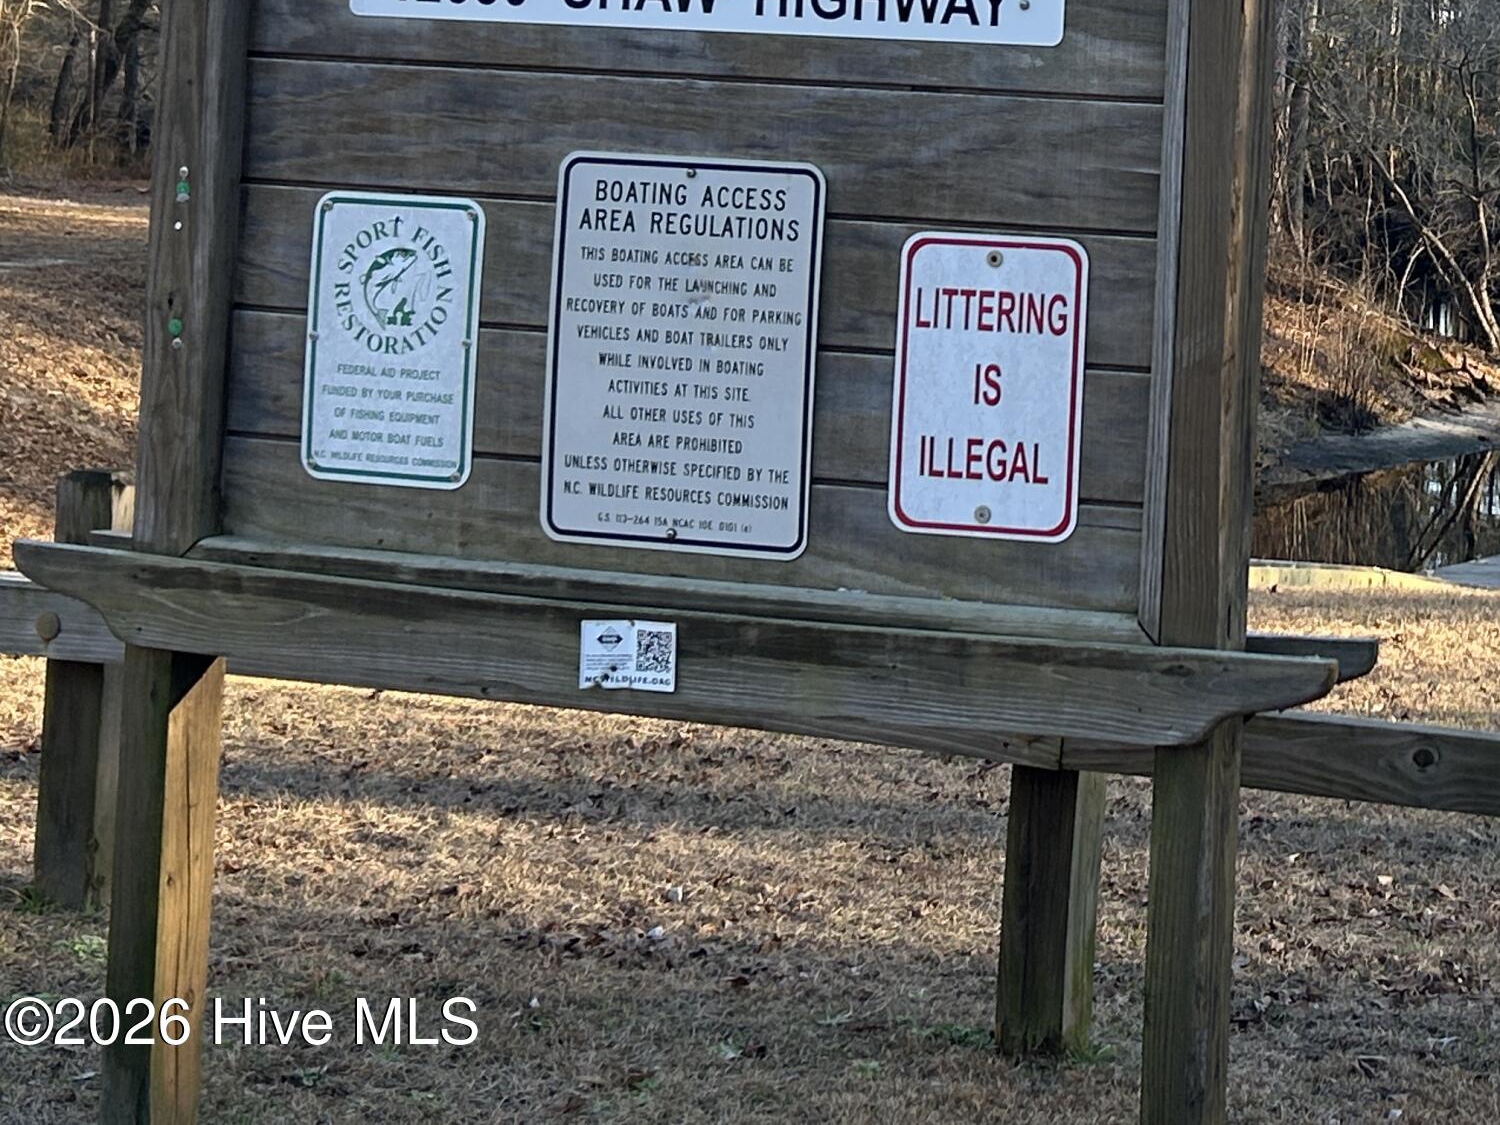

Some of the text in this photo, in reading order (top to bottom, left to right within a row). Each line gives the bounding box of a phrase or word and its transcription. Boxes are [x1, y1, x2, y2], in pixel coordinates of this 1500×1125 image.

[595, 179, 787, 211] BOATING ACCESS
[579, 208, 800, 241] AREA REGULATIONS
[337, 217, 453, 278] SPORT FISH
[581, 246, 794, 273] THIS BOATING ACCESS AREA CAN BE
[593, 273, 776, 297] USED FOR THE LAUNCHING AND
[334, 282, 454, 355] RESTORATION
[566, 297, 802, 326] RECOVERY OF BOATS AND FOR PARKING
[915, 287, 1068, 336] LITTERING
[577, 325, 789, 352] VEHICLES AND BOAT TRAILERS ONLY
[337, 363, 441, 380] FEDERAL AID PROJECT
[598, 352, 765, 376] WHILE INVOLVED IN BOATING
[322, 384, 455, 404] FUNDED BY YOUR PURCHASE
[608, 379, 668, 396] ACTIVITIES
[674, 383, 687, 397] AT
[694, 384, 719, 400] THIS
[974, 363, 1002, 406] IS
[334, 407, 440, 425] OF FISHING EQUIPMENT
[603, 405, 755, 429] ALL OTHER USES OF THIS
[329, 429, 444, 448] AND MOTOR BOAT FUELS
[613, 432, 743, 454] AREA ARE PROHIBITED
[564, 454, 789, 485] UNLESS OTHERWISE SPECIFIED BY THE
[919, 435, 1049, 485] ILLEGAL
[588, 483, 639, 500] WILDLIFE
[645, 486, 712, 505] RESOURCES
[717, 492, 789, 511] COMMISSION
